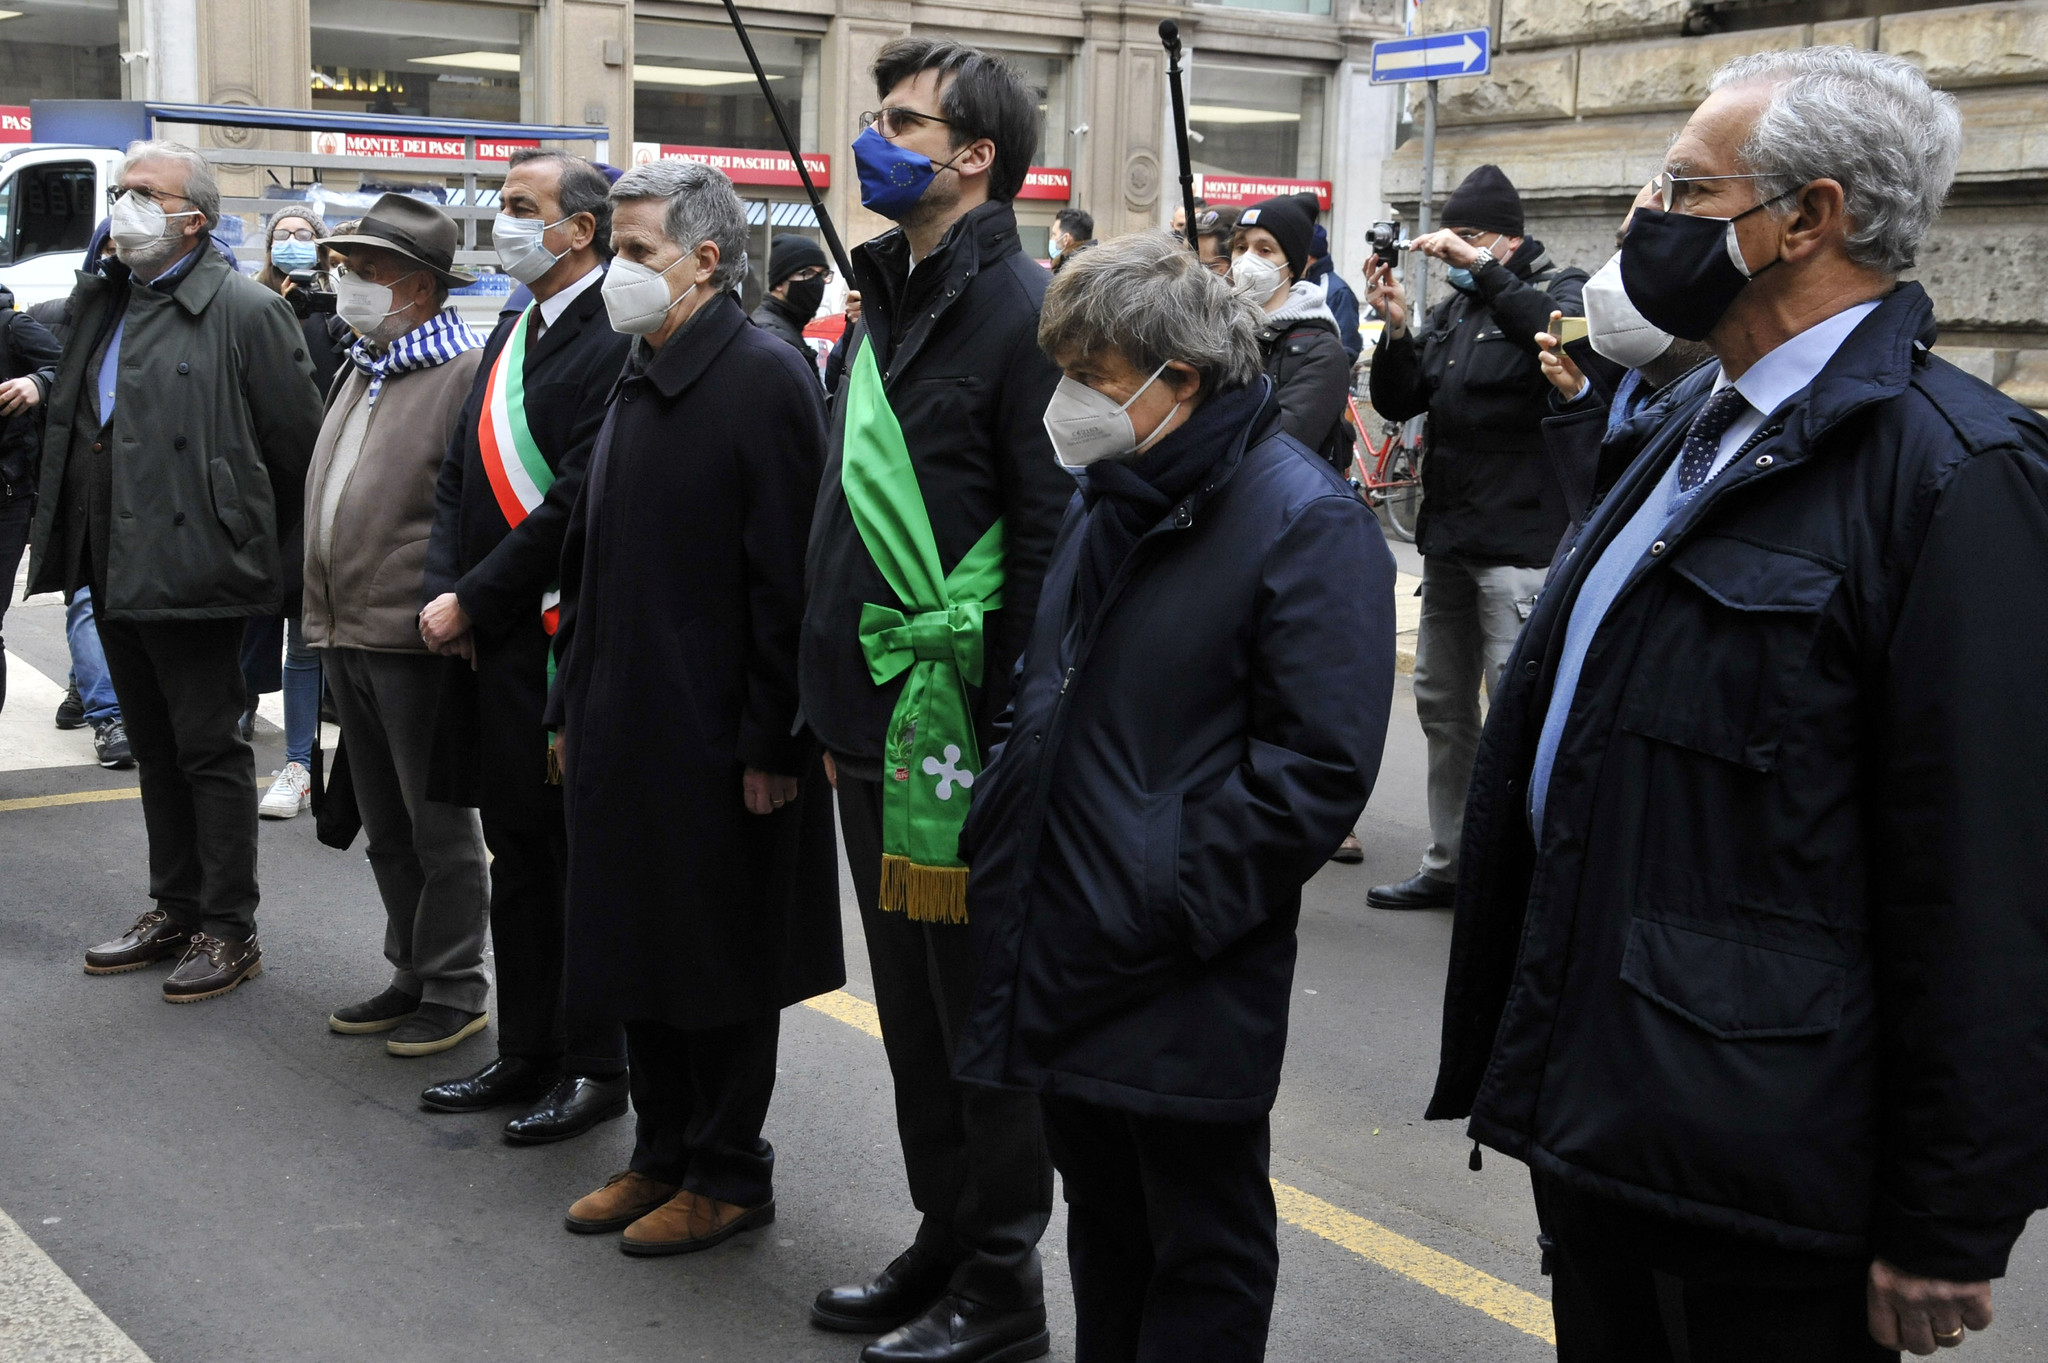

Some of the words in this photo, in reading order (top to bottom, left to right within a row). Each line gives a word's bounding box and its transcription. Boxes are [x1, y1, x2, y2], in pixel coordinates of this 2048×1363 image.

[347, 137, 400, 152] MONTE
[403, 140, 426, 153] DEI
[429, 141, 476, 155] PASC
[480, 144, 494, 157] DI
[710, 155, 731, 168] DEI
[732, 156, 775, 170] PASCHI
[777, 159, 790, 171] DI
[790, 160, 826, 173] SENA
[1025, 173, 1037, 185] DI
[1037, 174, 1068, 186] SIENA
[1205, 181, 1240, 193] MONTE
[1240, 183, 1256, 194] DEI
[1257, 184, 1289, 195] PASCHI
[1289, 185, 1300, 196] DI
